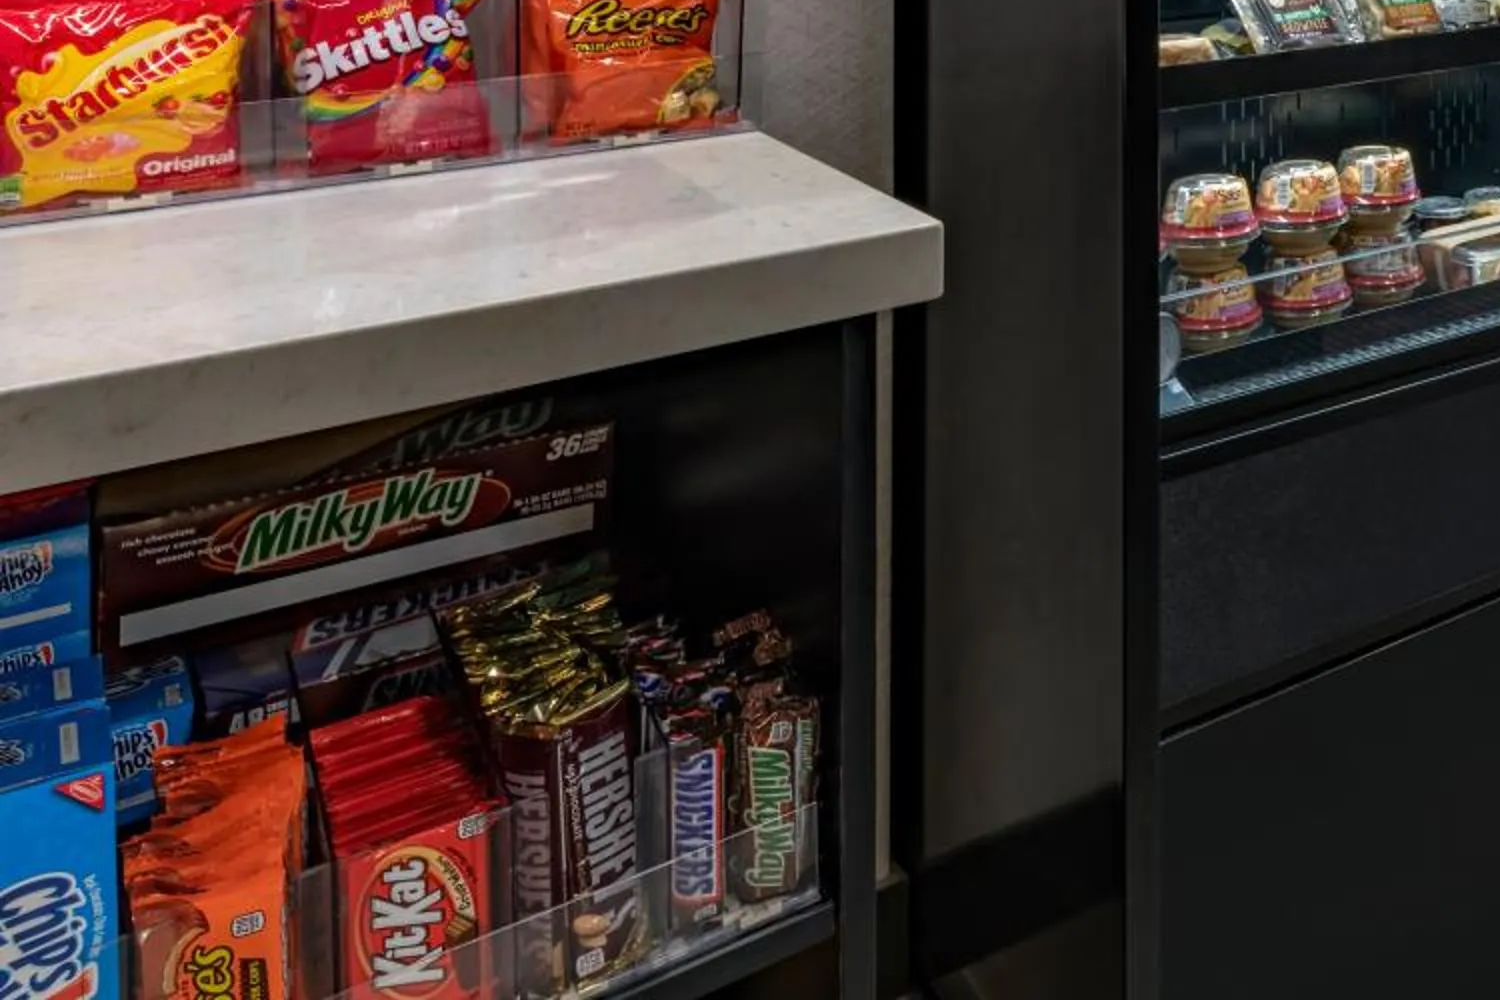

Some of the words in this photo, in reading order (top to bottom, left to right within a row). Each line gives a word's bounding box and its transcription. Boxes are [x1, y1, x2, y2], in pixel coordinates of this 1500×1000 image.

[292, 8, 469, 94] Skittles
[14, 14, 231, 149] Starburst
[142, 148, 237, 176] Original
[545, 433, 582, 461] 36
[0, 543, 42, 576] hips
[114, 726, 155, 757] hips
[672, 749, 716, 894] SNICKERS
